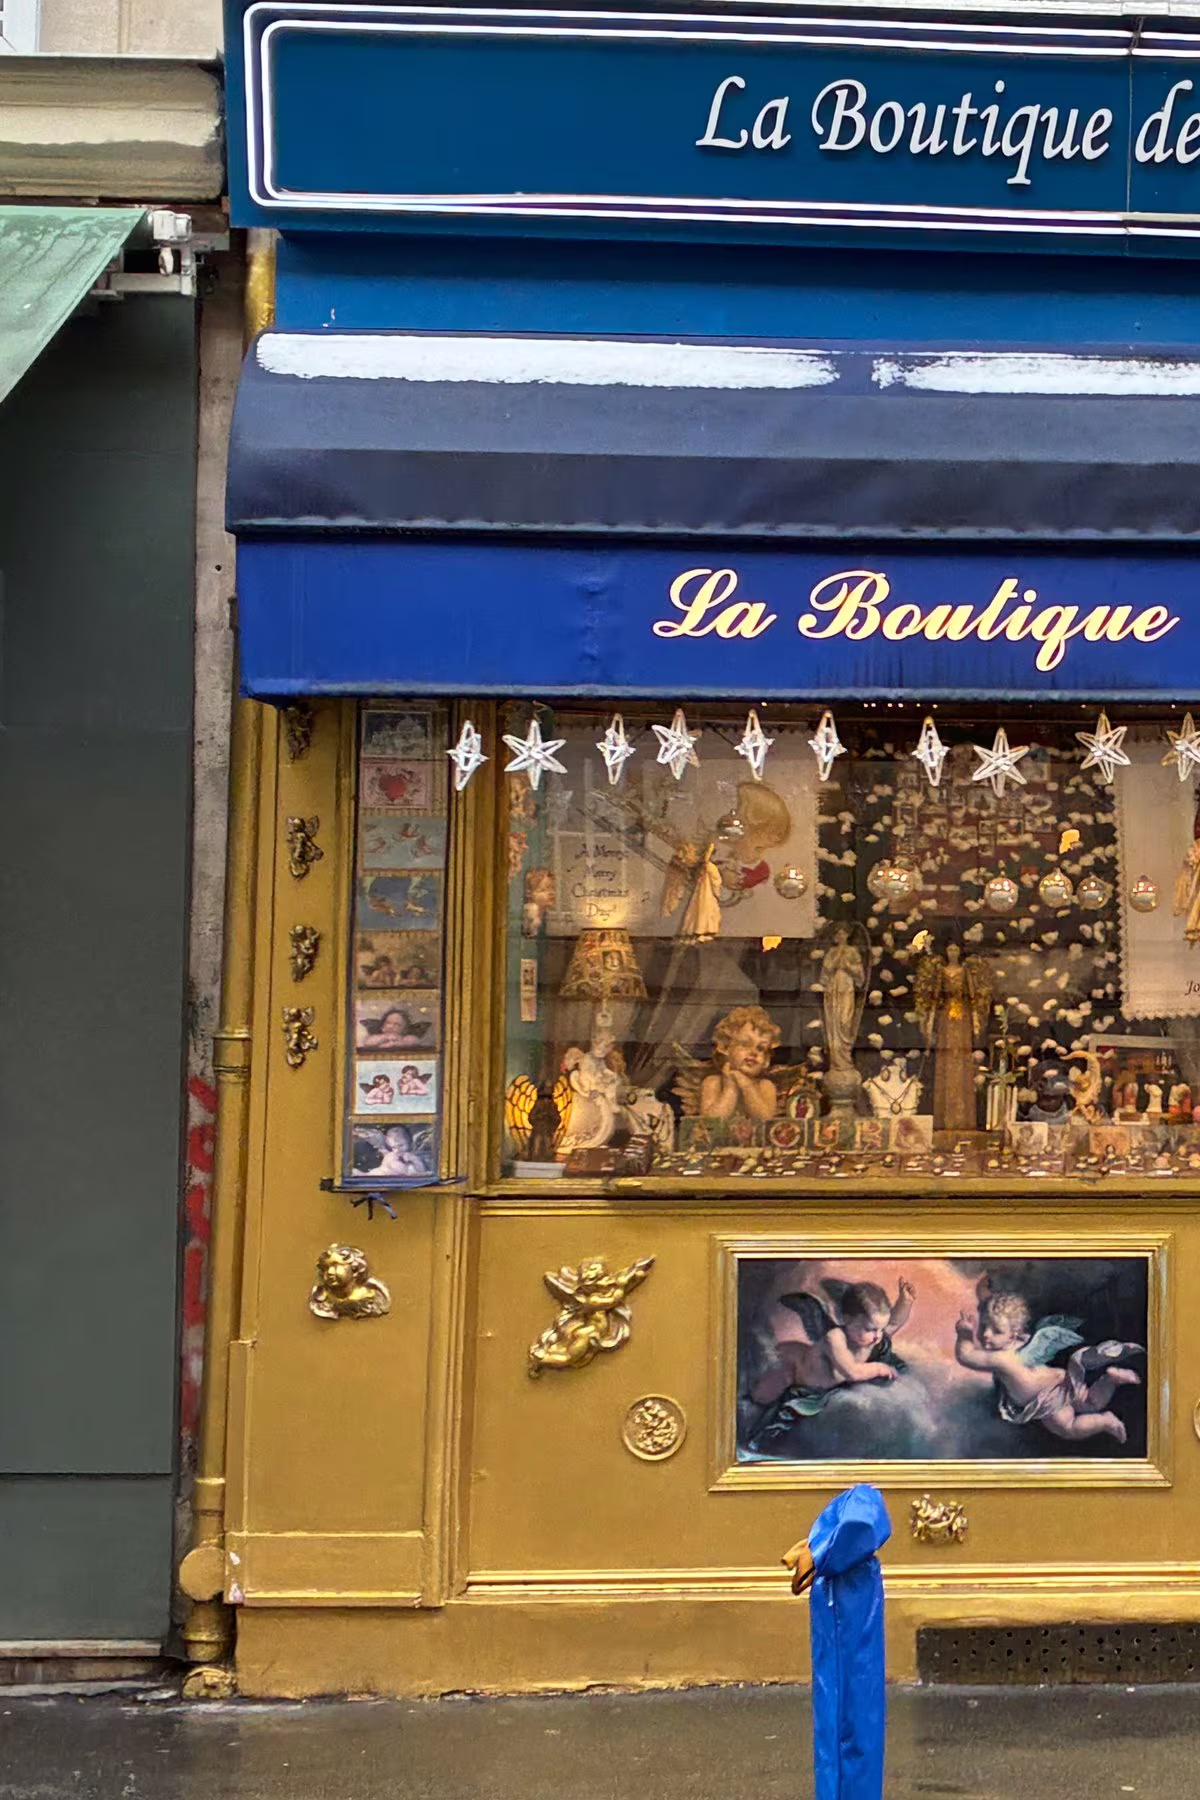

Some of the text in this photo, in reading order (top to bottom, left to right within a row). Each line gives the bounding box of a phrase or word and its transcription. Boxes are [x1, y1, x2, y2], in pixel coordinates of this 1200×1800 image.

[695, 75, 792, 150] La
[811, 78, 1113, 186] Boutique
[652, 567, 778, 640] La
[798, 569, 1181, 673] Boutique
